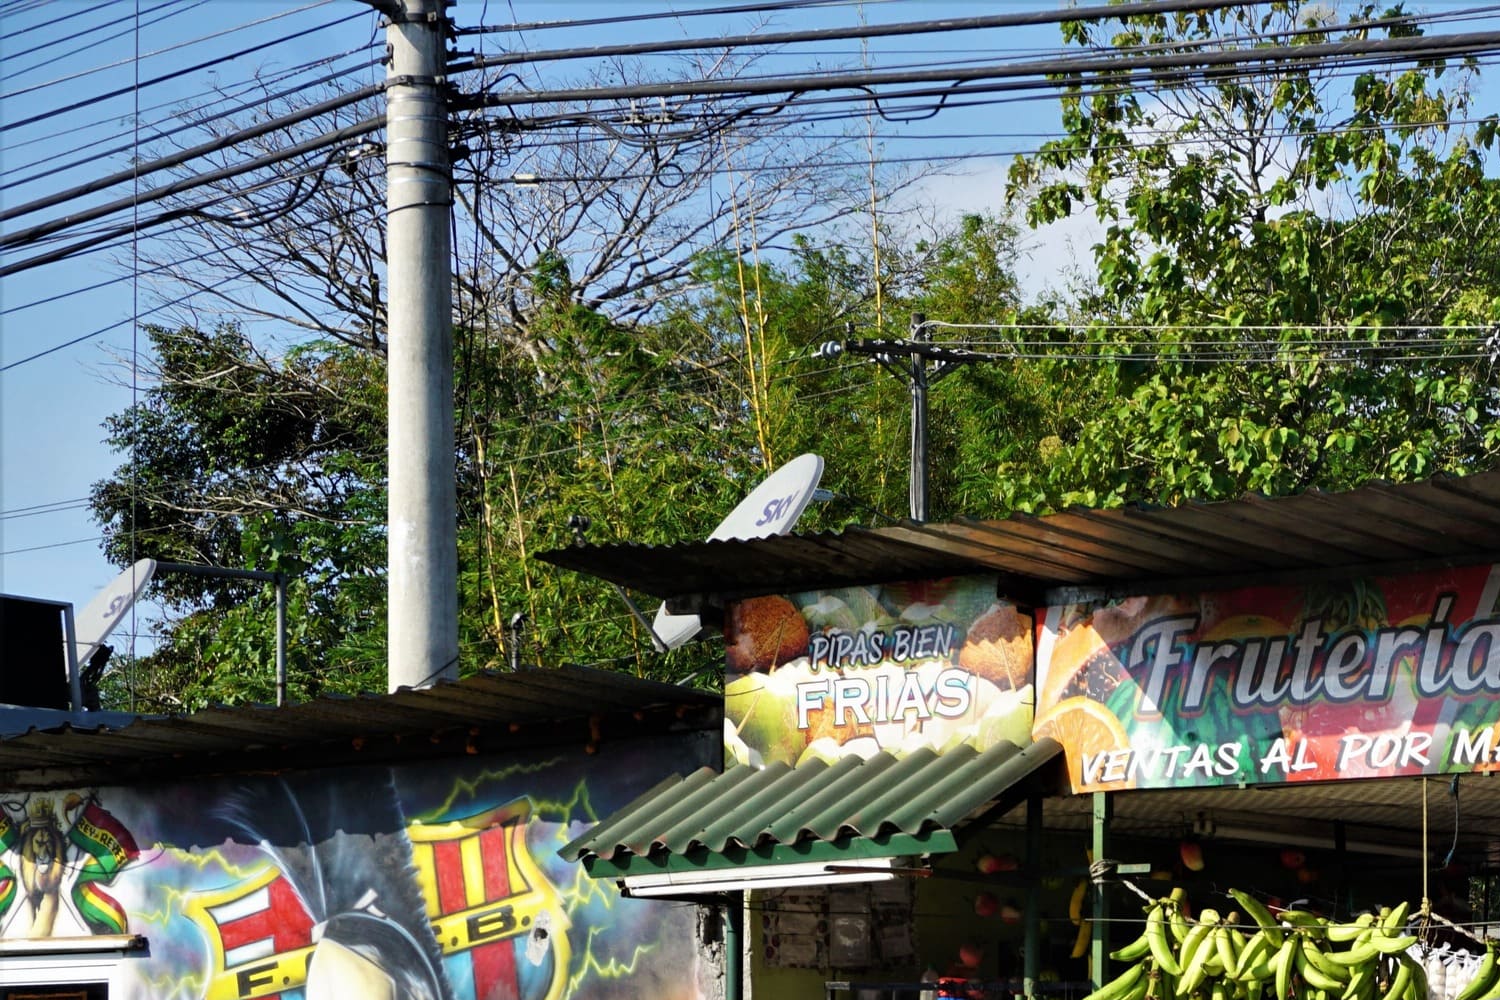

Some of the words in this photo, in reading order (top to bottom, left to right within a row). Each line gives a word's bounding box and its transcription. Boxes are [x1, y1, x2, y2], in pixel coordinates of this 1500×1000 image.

[756, 490, 801, 527] SKY
[812, 631, 885, 671] PIPAS
[893, 626, 953, 662] BIEN
[796, 667, 972, 729] FRIAS
[1081, 743, 1243, 784] VENTAS
[1260, 737, 1318, 774] AL
[1338, 731, 1431, 770] POR
